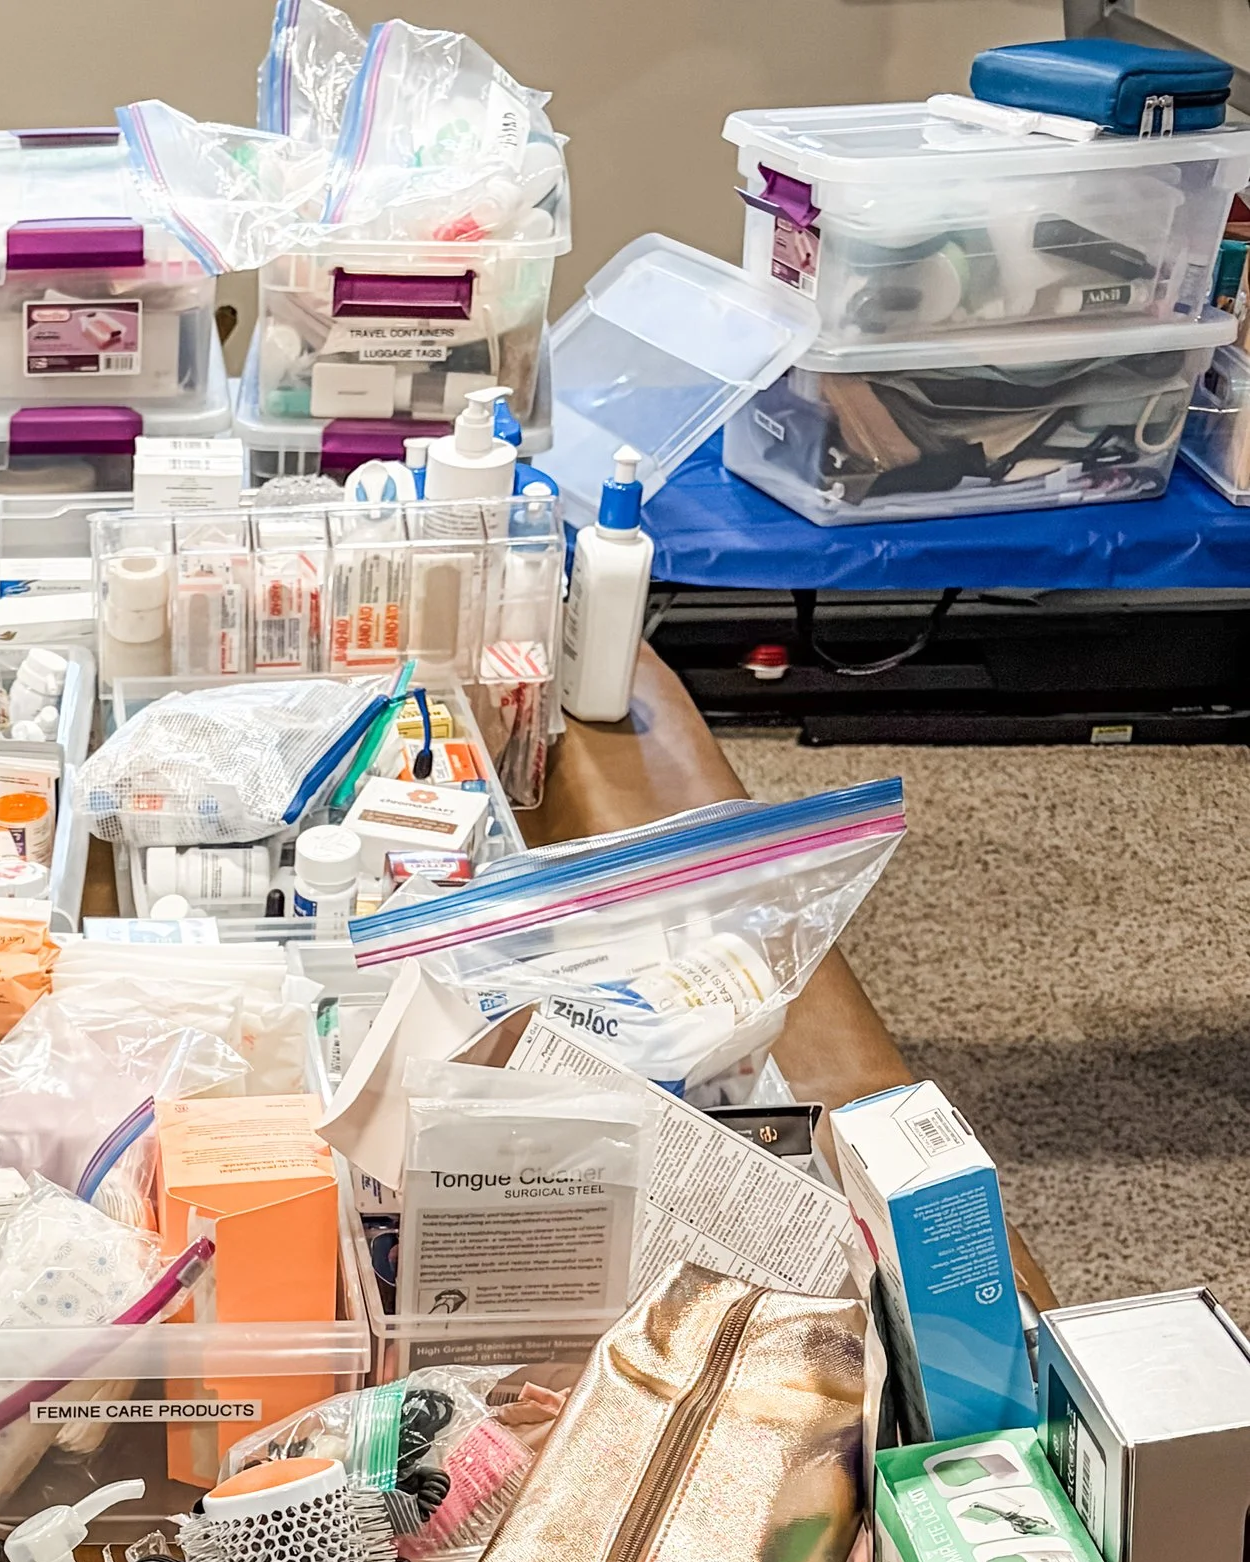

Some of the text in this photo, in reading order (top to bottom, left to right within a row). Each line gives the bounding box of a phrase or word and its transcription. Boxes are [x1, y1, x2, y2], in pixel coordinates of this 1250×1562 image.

[350, 328, 455, 338] TRAVEL CONTAINERS
[364, 349, 442, 358] LUGGAGE TAGS
[560, 954, 610, 974] Suppositories
[431, 1170, 511, 1191] Tongue
[504, 1185, 605, 1199] SURGICAL STEEL
[416, 1347, 440, 1356] High
[443, 1345, 473, 1353] Grade
[475, 1342, 519, 1351] Stainless
[454, 1354, 479, 1362] used
[493, 1351, 513, 1360] this
[37, 1404, 254, 1418] FEMINE CARE PRODUCTS
